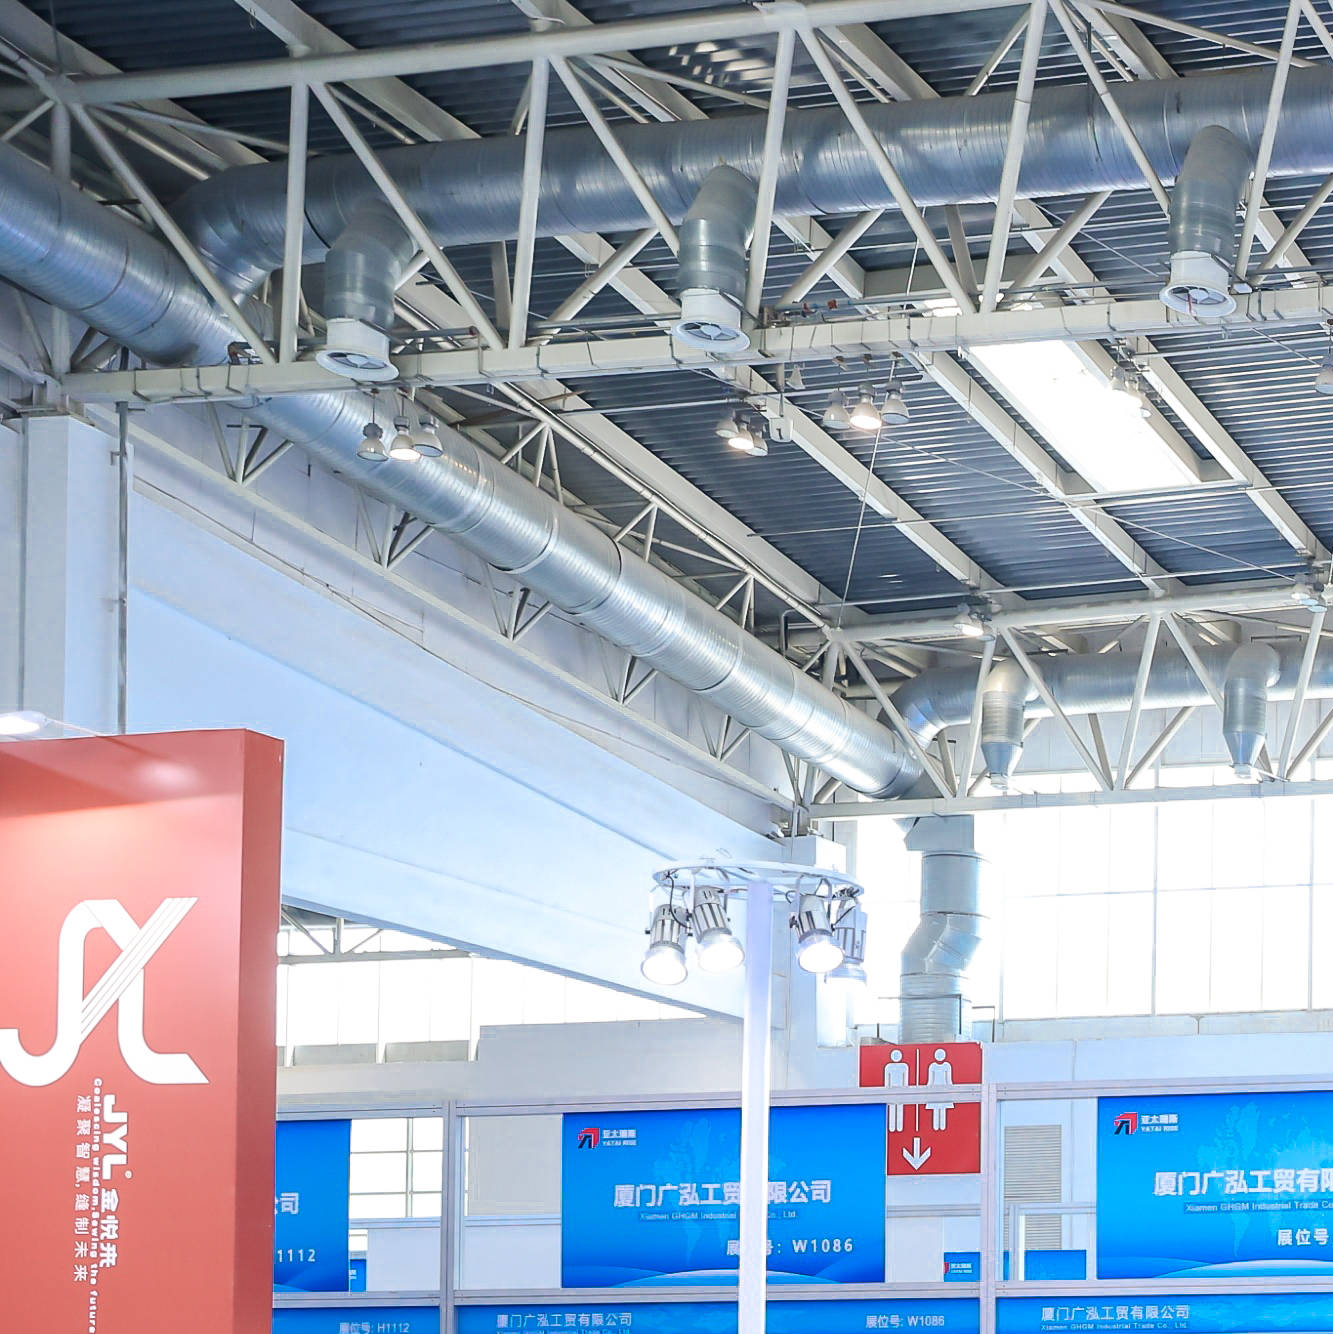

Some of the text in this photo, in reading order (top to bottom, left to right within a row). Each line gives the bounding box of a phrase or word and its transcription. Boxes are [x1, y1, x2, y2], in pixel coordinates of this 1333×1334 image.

[614, 1180, 832, 1207] 厦门广泓工贸限公司
[792, 1239, 853, 1253] W1086
[1041, 1305, 1191, 1321] 厦门广泓工贸有限公司
[907, 1316, 945, 1327] W1086
